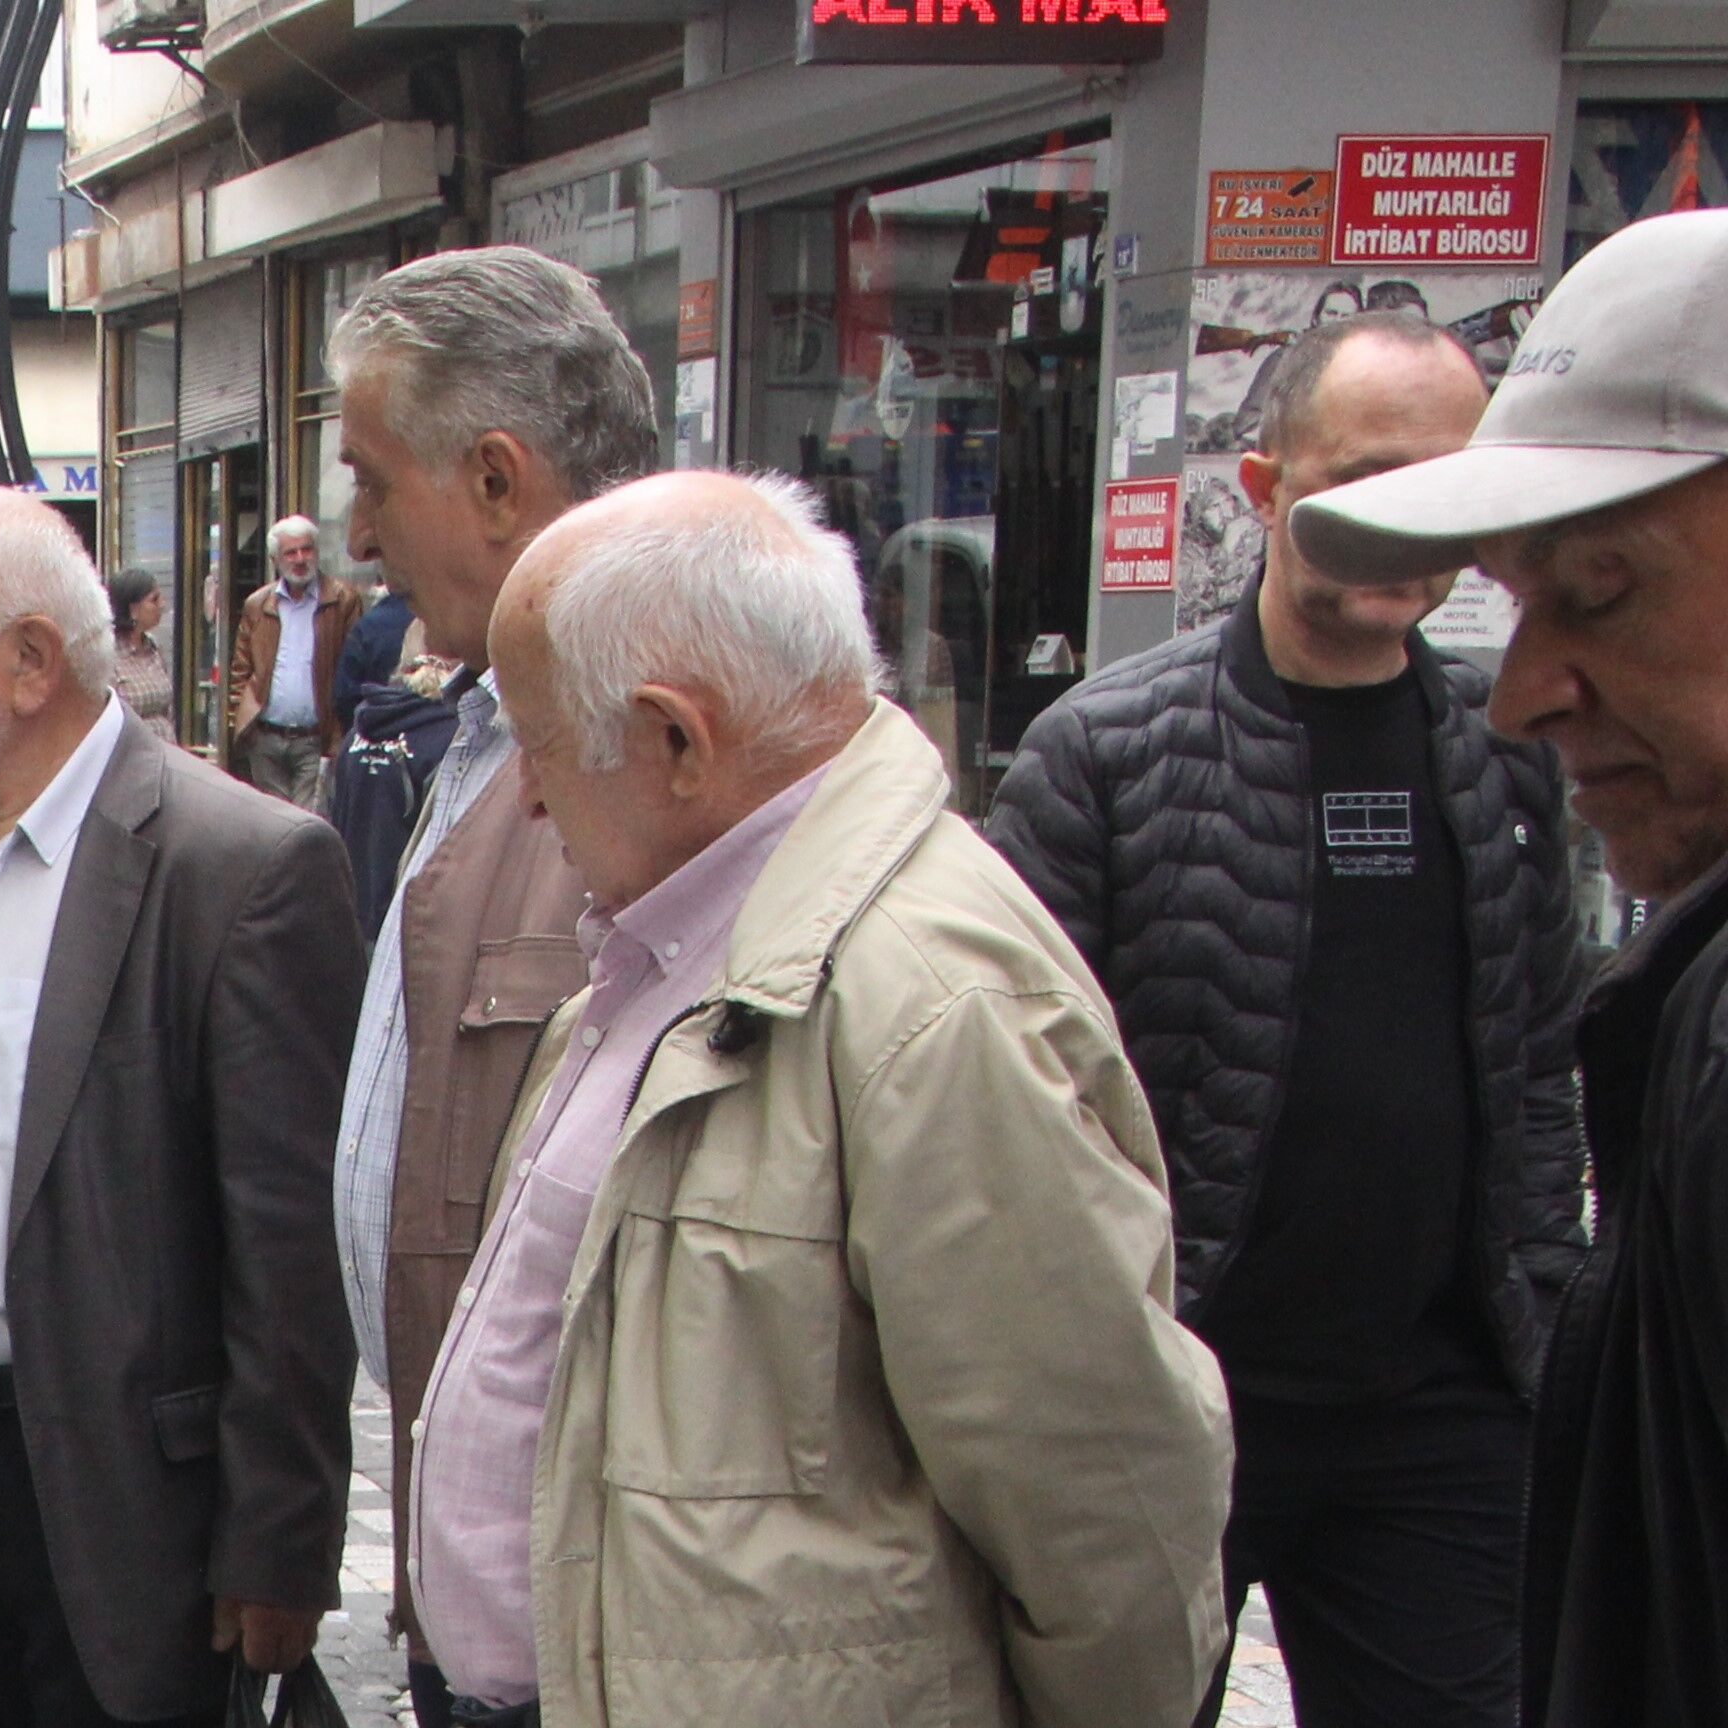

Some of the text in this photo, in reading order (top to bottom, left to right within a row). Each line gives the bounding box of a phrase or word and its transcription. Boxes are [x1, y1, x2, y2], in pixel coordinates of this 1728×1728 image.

[1361, 146, 1515, 177] DÜZ MAHALLE
[1271, 207, 1322, 218] SAAT
[1373, 184, 1510, 216] MUHTARLIĞI
[1345, 223, 1528, 254] İRTİBAT BÜROSU
